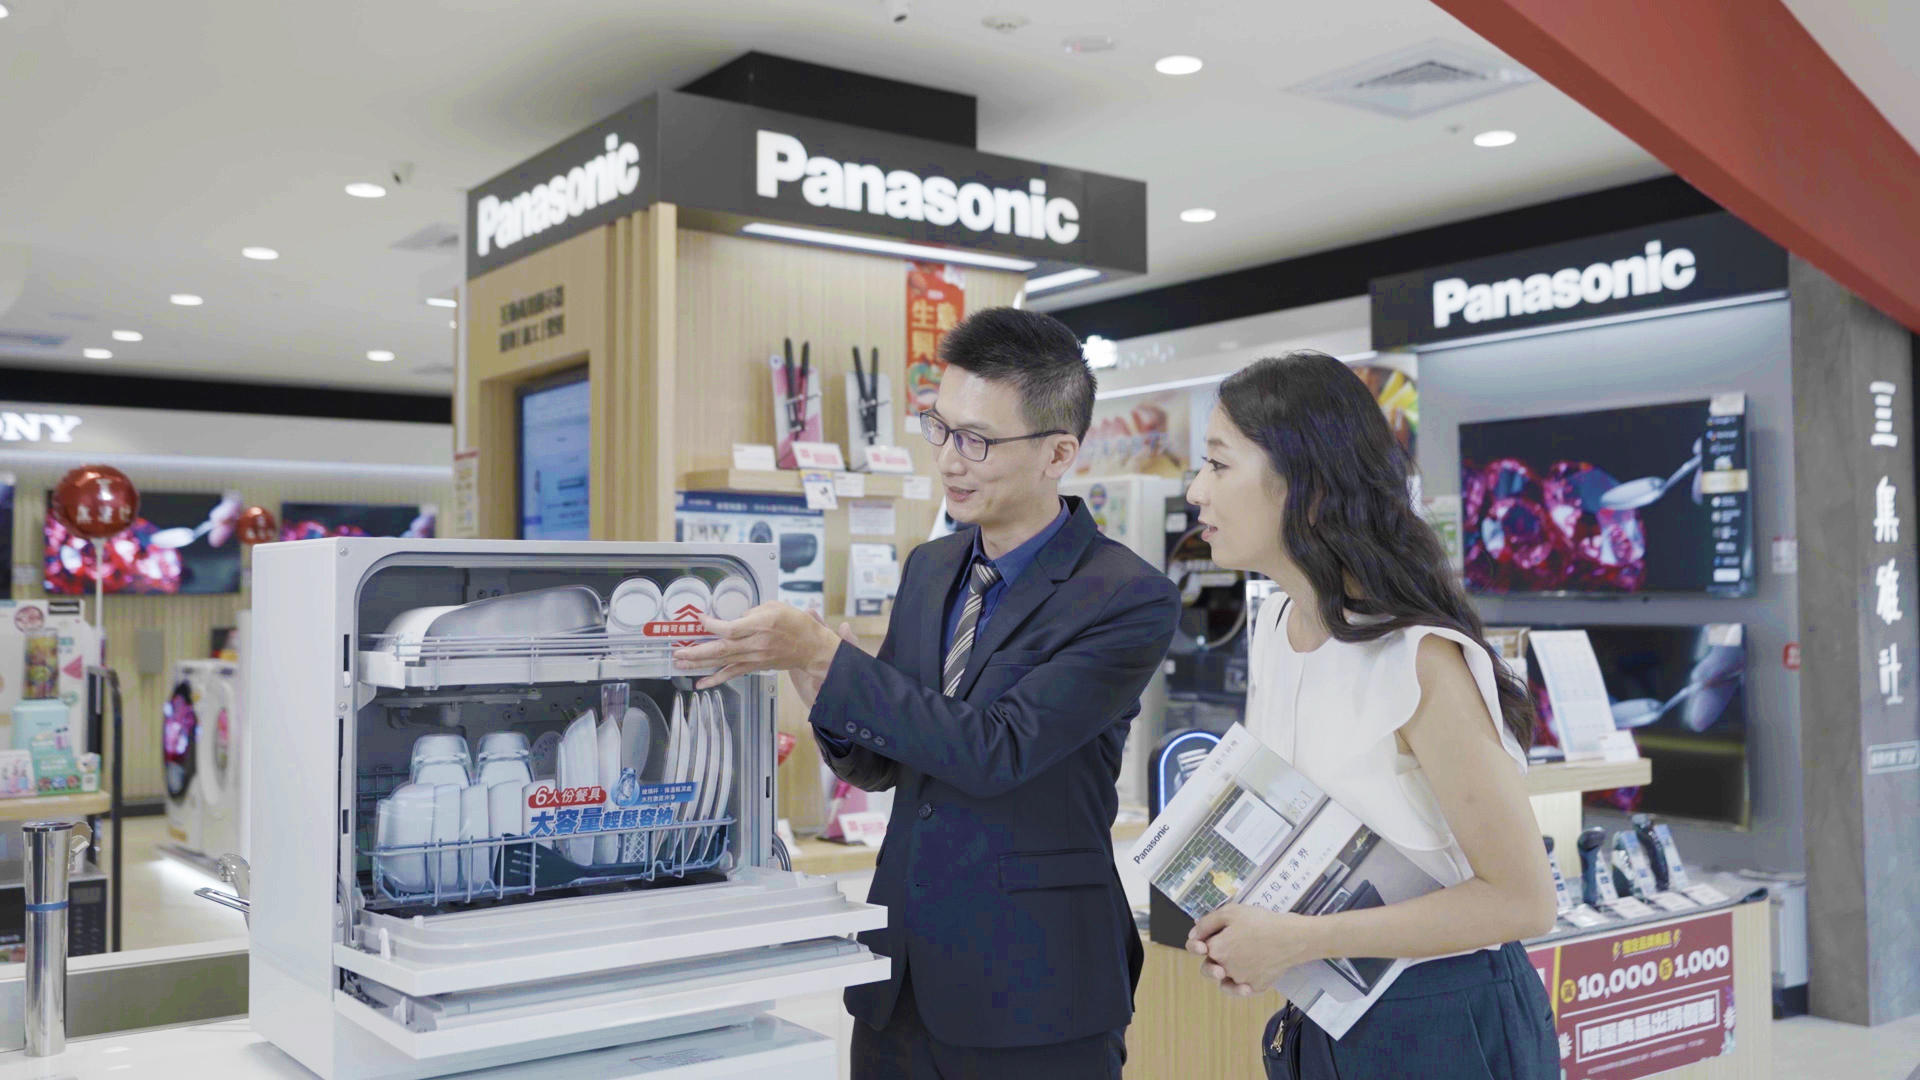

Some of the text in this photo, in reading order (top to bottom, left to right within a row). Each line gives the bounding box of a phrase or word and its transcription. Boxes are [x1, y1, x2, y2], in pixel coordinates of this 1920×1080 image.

[477, 133, 641, 257] Panasonic
[755, 130, 1081, 245] Panasonic
[1432, 240, 1697, 329] Panasonic
[0, 411, 83, 443] NY
[535, 786, 602, 806] 6人份餐具
[529, 806, 675, 837] 大容量輕鬆容納
[1133, 824, 1170, 864] Panasonic
[1577, 960, 1658, 1001] 10,000
[1674, 944, 1730, 979] 1,000
